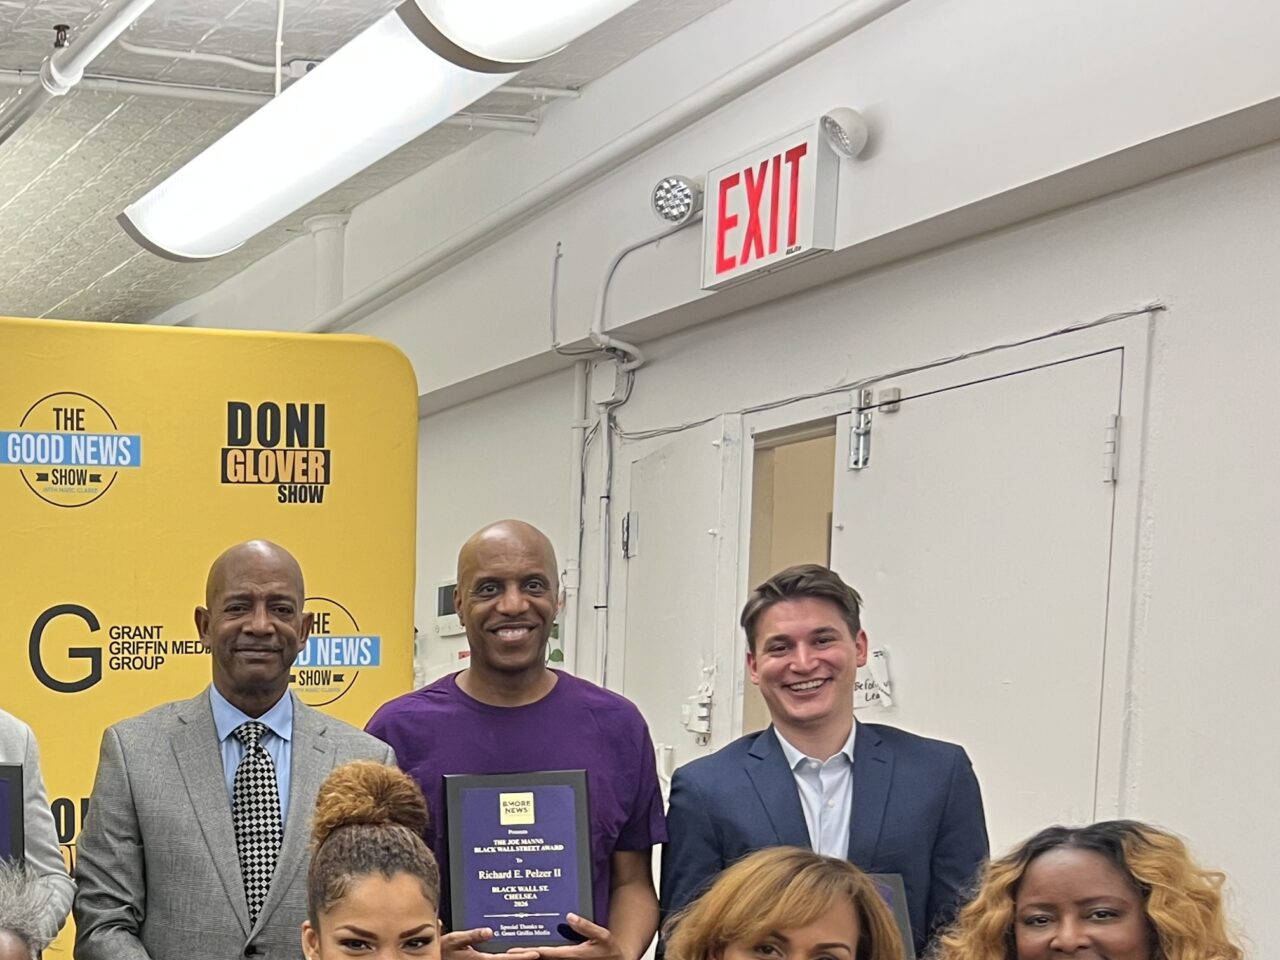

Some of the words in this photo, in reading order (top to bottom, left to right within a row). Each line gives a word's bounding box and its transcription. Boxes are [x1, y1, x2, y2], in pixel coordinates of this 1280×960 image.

[716, 142, 808, 275] EXIT
[53, 408, 85, 431] THE
[228, 401, 325, 448] DONI
[7, 433, 64, 463] GOOD
[71, 435, 131, 465] NEWS
[226, 449, 325, 483] GLOVER
[52, 469, 87, 485] SHOW
[278, 485, 324, 503] SHOW
[109, 626, 163, 640] GRANT
[311, 613, 330, 634] HE
[29, 604, 102, 693] G
[109, 641, 167, 655] GRIFFIN
[317, 638, 371, 665] NEWS
[109, 657, 164, 670] GROUP
[299, 670, 331, 686] SHOW
[479, 870, 512, 880] Richard
[514, 870, 523, 878] E.
[526, 869, 552, 878] Pelzer
[554, 868, 561, 877] II
